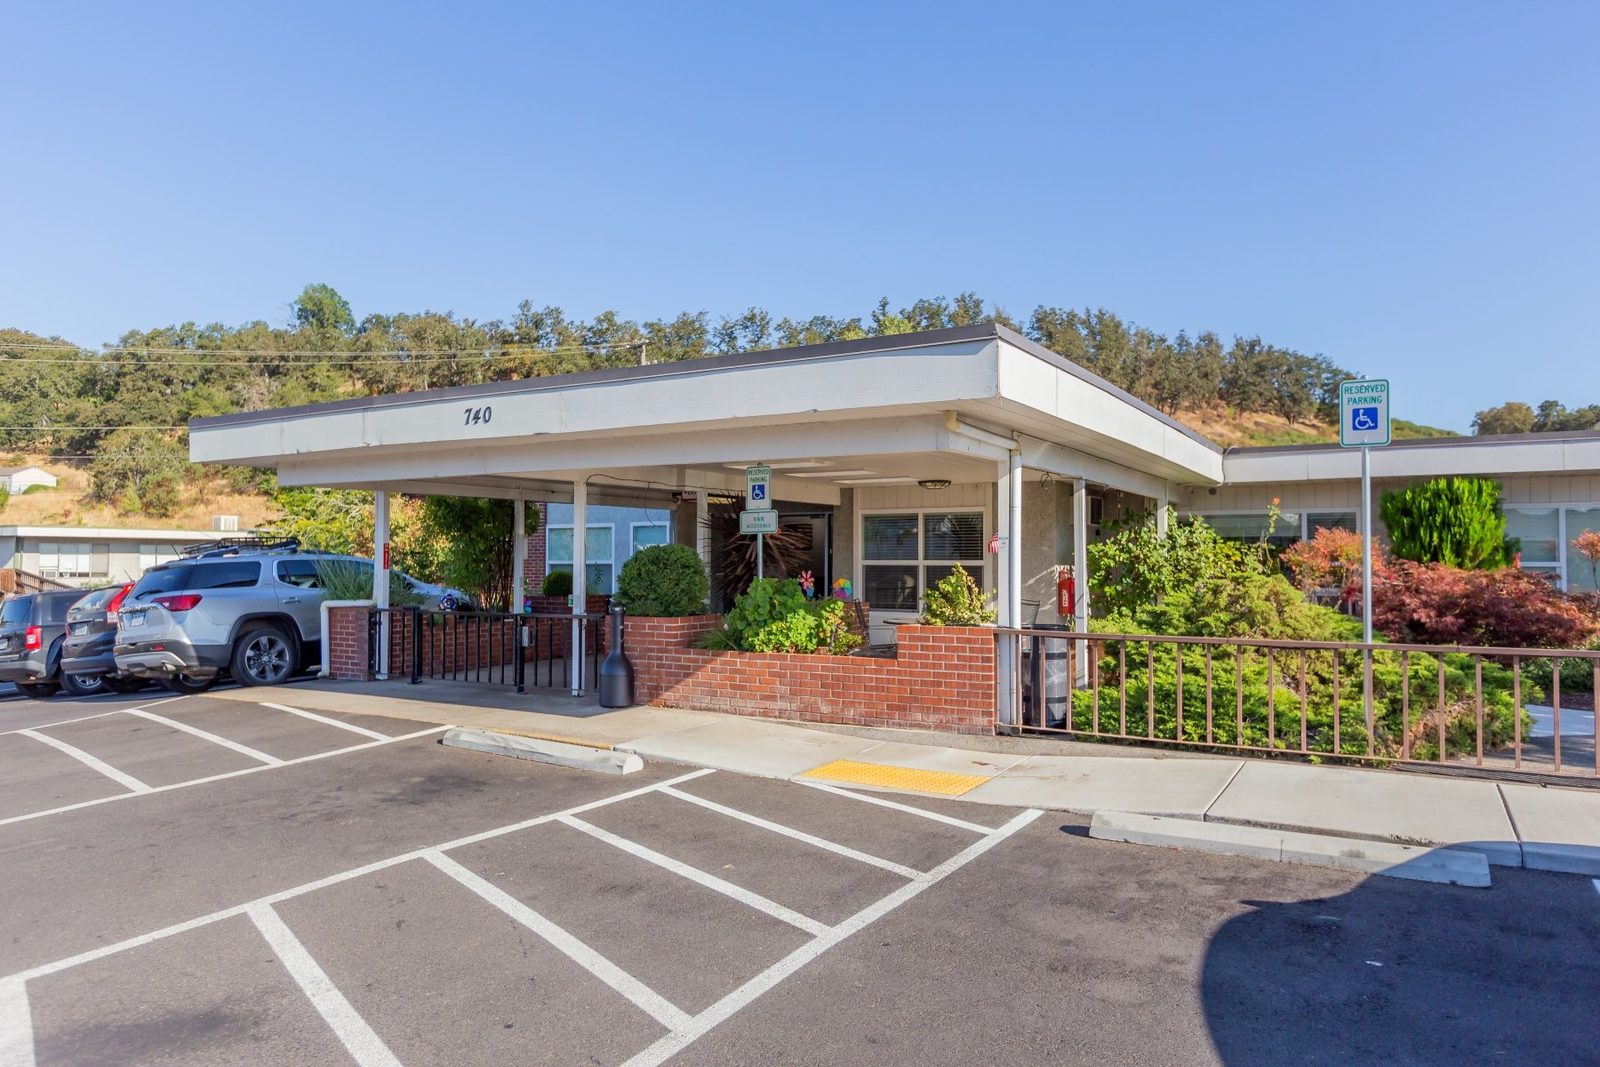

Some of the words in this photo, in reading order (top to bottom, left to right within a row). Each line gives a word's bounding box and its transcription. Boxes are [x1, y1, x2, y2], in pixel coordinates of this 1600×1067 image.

[1344, 384, 1386, 395] RESERVED
[1347, 395, 1383, 406] PARKING
[464, 406, 492, 425] 740
[748, 468, 769, 476] RESERVED
